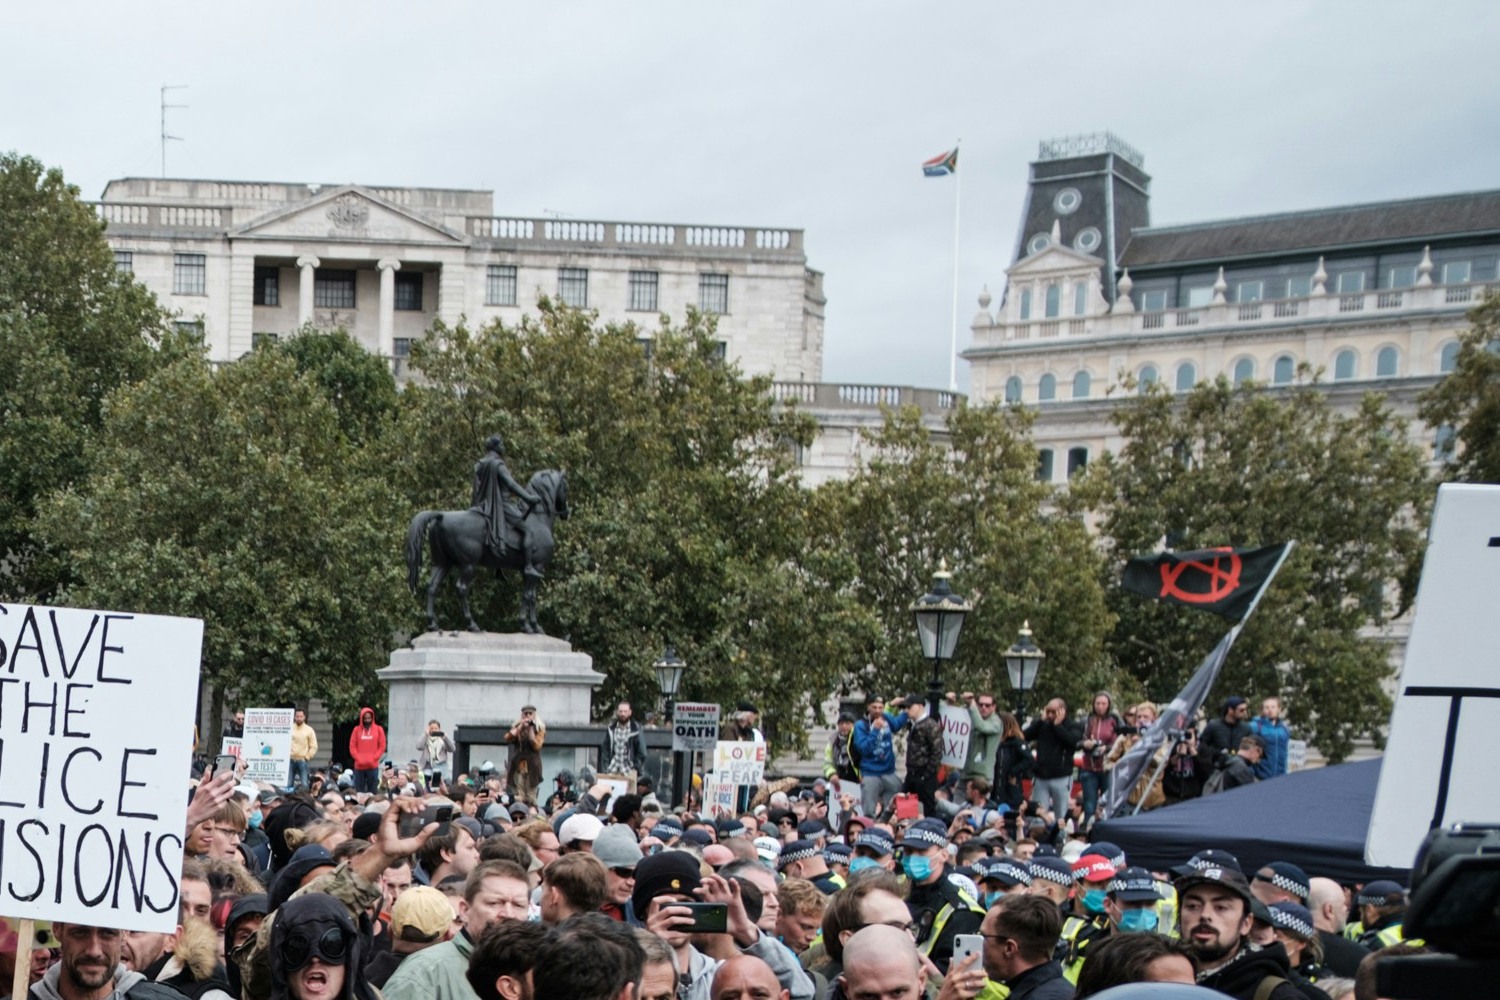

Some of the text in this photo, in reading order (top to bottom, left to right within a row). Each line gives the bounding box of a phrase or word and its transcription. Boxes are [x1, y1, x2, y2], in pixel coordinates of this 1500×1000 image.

[677, 705, 716, 713] REMEMBER
[266, 715, 273, 725] 19
[273, 715, 291, 725] CASES
[675, 725, 716, 738] OATH
[260, 762, 277, 771] TESTS
[720, 770, 760, 784] FEAR
